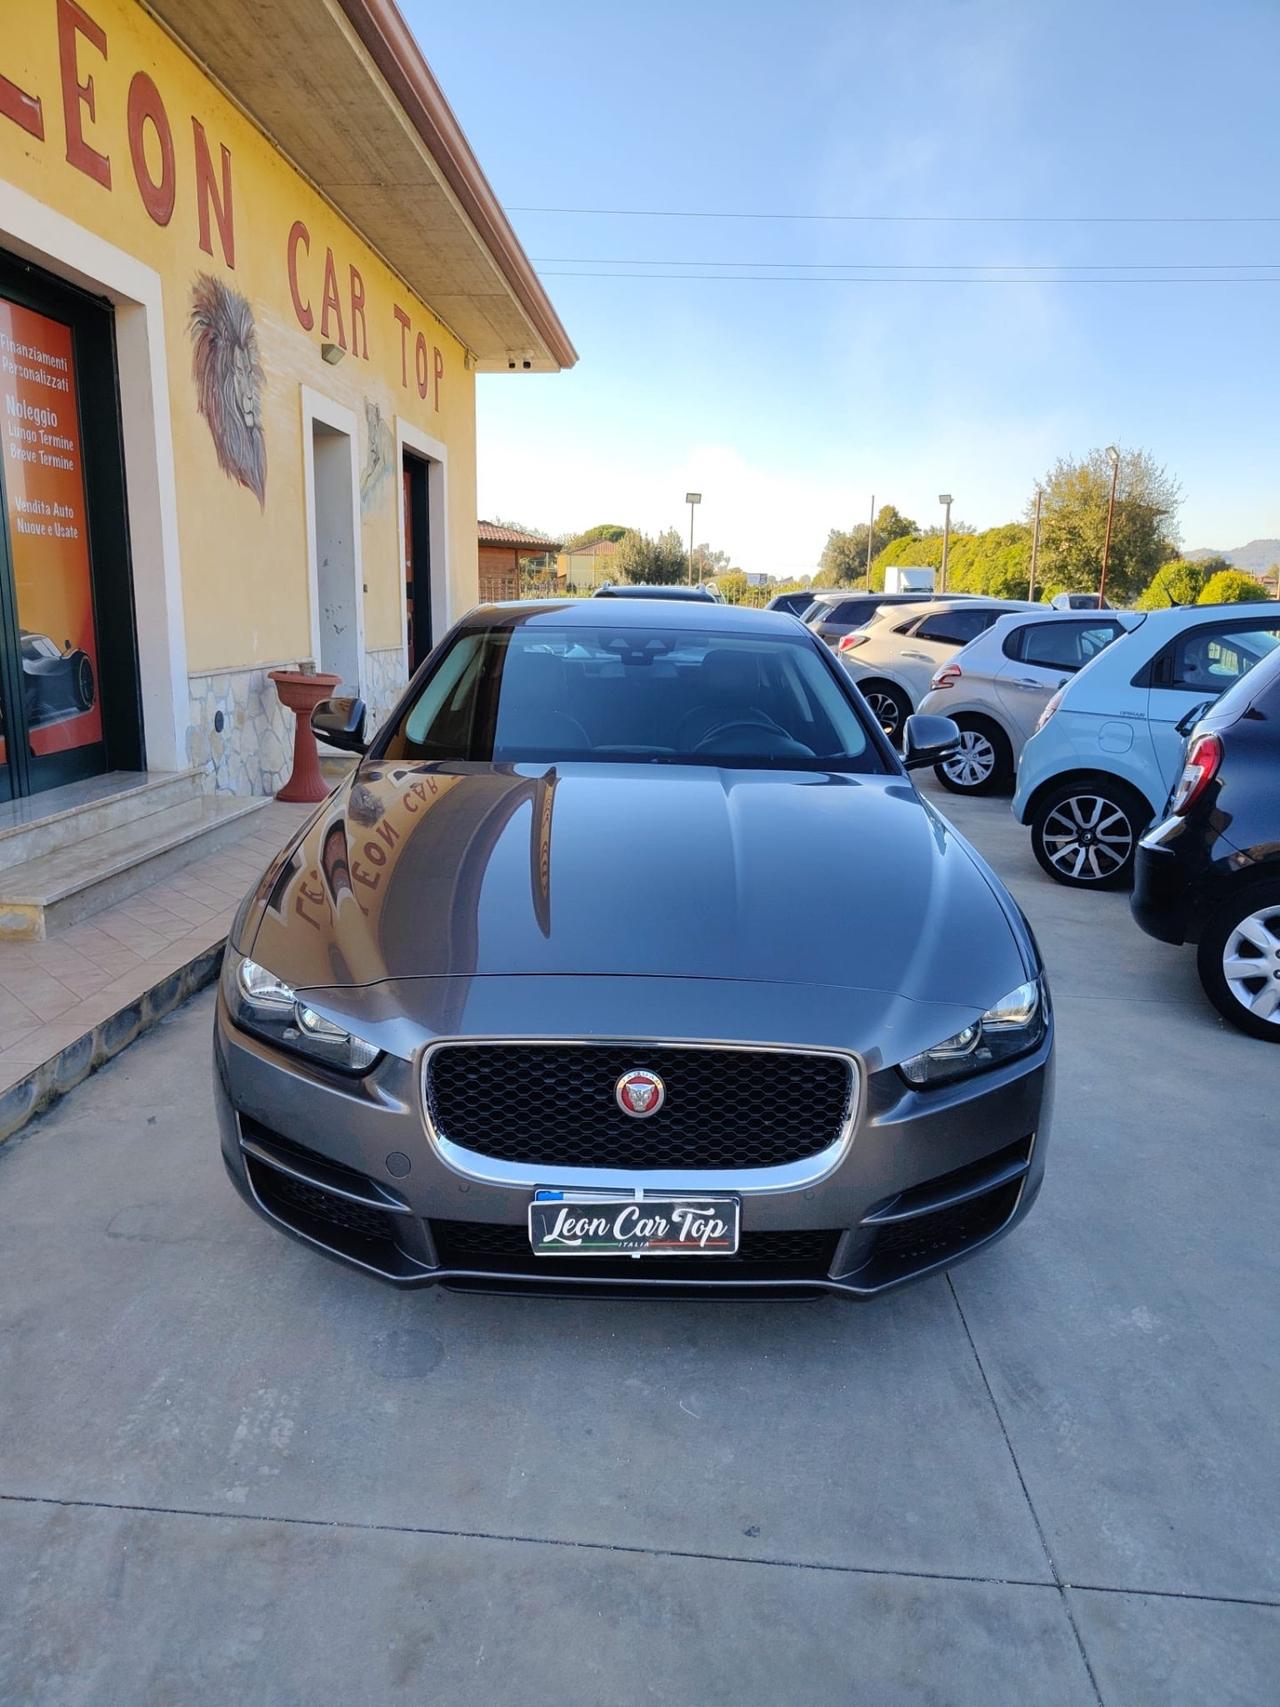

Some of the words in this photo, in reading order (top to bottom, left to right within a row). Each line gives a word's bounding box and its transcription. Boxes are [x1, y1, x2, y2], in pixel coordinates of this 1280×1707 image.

[287, 220, 369, 361] CAR
[394, 303, 443, 413] TOP
[0, 334, 68, 372] Finanziamenti
[5, 394, 58, 428] Noleggio
[8, 420, 37, 444] Lungo
[39, 429, 74, 451] Termine
[10, 442, 37, 464] Breve
[39, 450, 74, 471] Termine
[15, 496, 51, 516] Vendita
[54, 501, 75, 518] Auto
[17, 518, 46, 536] Nuove
[48, 525, 53, 536] e
[54, 522, 79, 539] Usate
[543, 1208, 610, 1246] Leon
[613, 1206, 670, 1240] Car
[672, 1207, 728, 1247] Top
